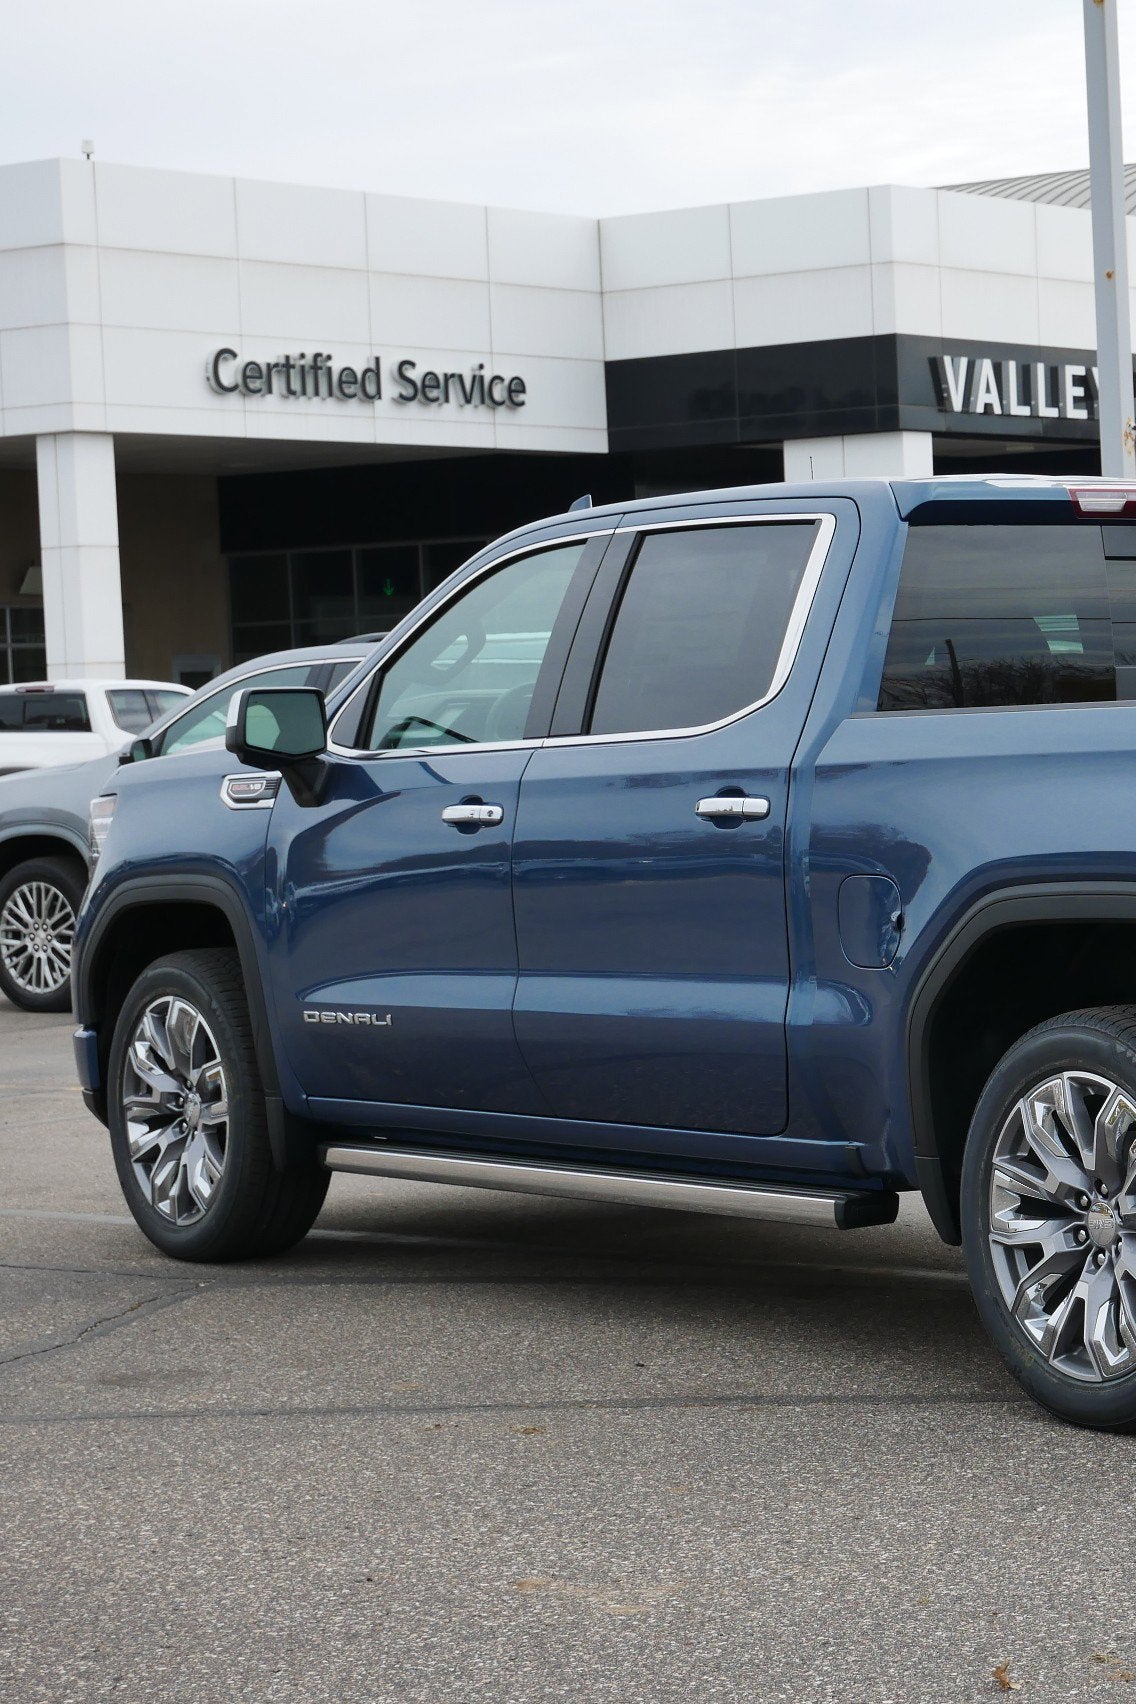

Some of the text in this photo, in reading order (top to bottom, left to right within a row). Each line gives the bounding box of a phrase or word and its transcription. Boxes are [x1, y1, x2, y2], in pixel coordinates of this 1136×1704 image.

[210, 347, 528, 408] Certified Service
[942, 354, 1100, 420] VALLE
[303, 1010, 392, 1026] DENALI
